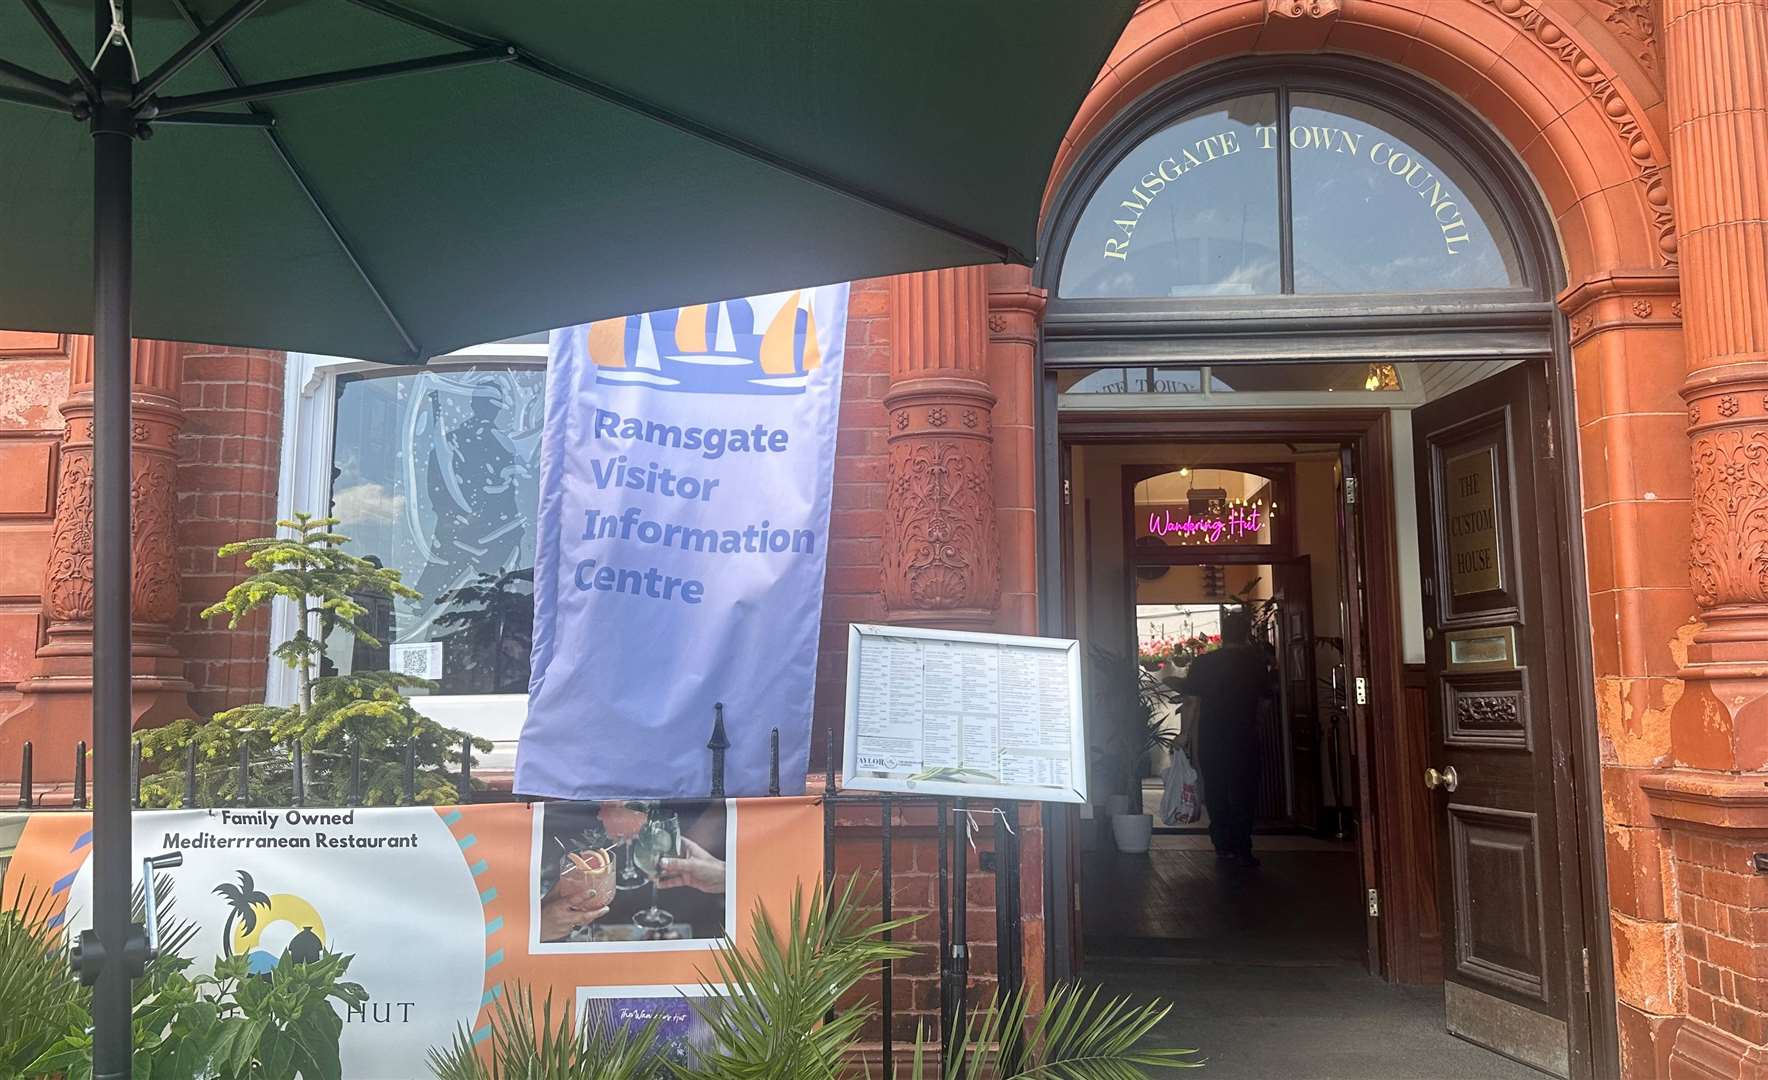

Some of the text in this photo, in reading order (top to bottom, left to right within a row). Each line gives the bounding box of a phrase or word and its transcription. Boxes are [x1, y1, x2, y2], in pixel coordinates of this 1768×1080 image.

[1103, 126, 1471, 262] RAMSGATE TOWN COUNCIL
[594, 408, 789, 460] Ramsgate
[590, 455, 720, 502] Visitor
[1459, 472, 1481, 498] THE
[582, 507, 815, 555] Information
[1149, 507, 1263, 543] Wandering Hut
[1451, 508, 1495, 537] CUSTOM
[1457, 548, 1492, 575] HOUSE
[574, 559, 705, 604] Centre
[221, 809, 355, 830] Family Owned
[162, 831, 418, 849] Mediterrranean Restaurant
[347, 1002, 415, 1024] HUT
